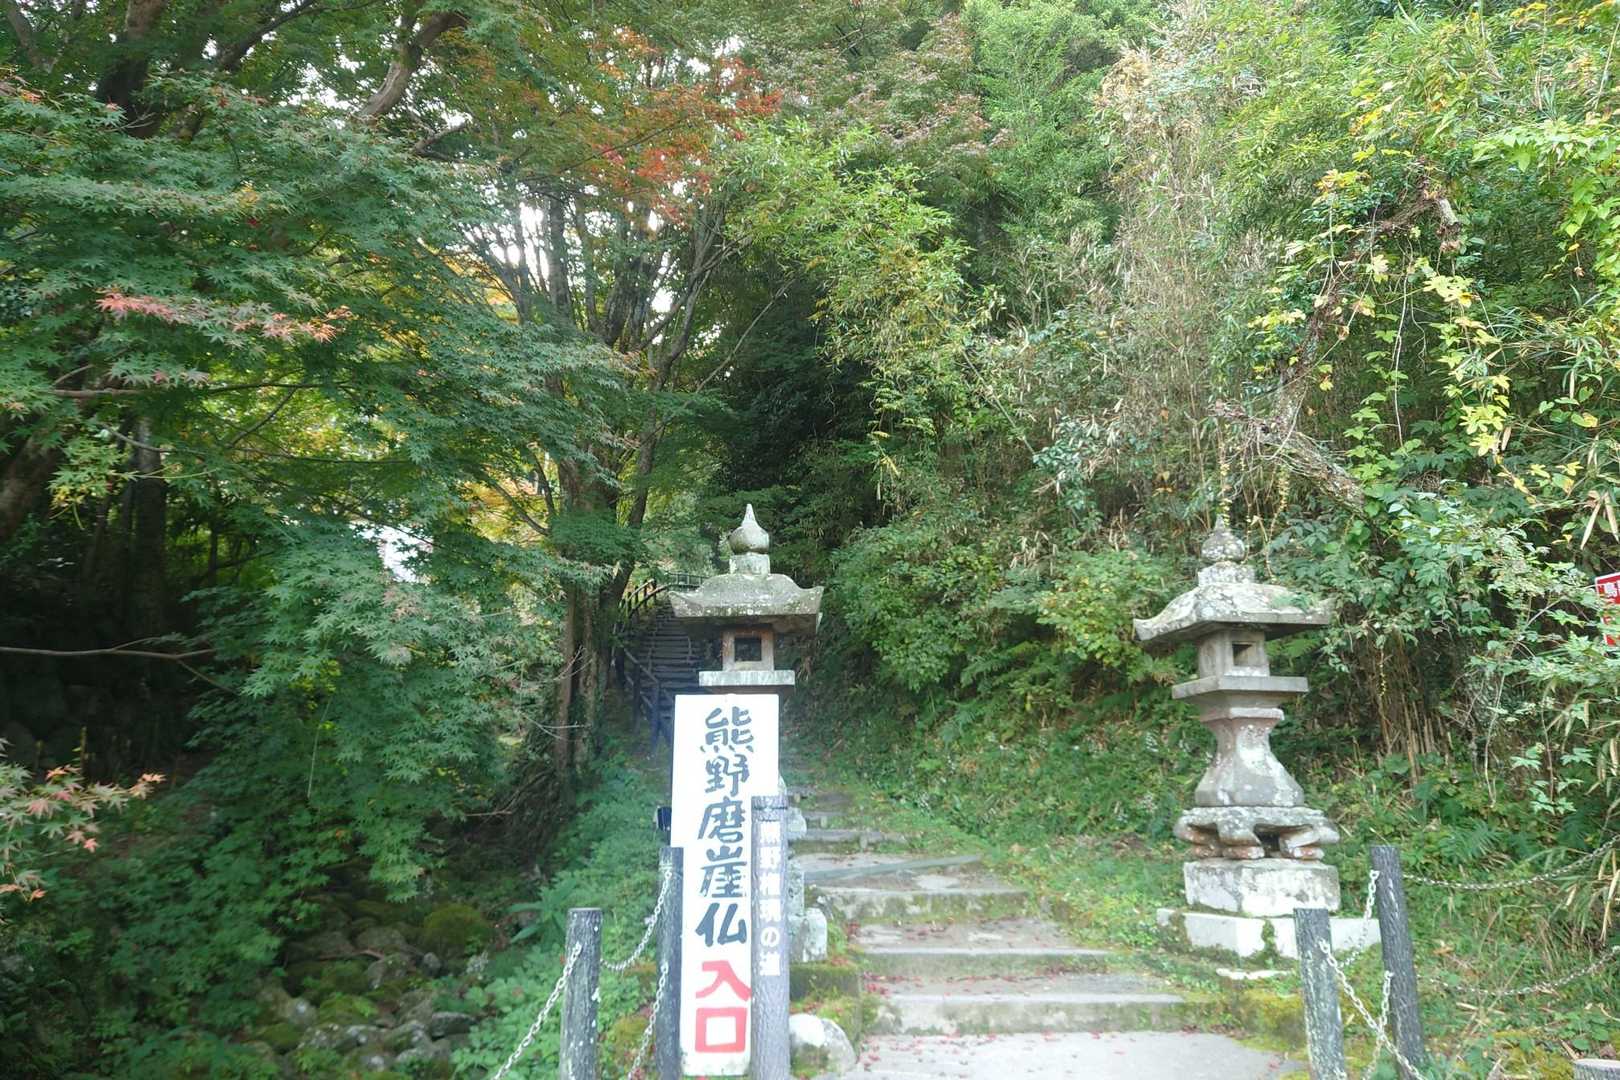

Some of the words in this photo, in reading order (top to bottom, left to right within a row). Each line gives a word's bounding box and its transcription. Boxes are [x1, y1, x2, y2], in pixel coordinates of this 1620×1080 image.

[695, 706, 754, 947] 熊野磨崖仏
[695, 960, 752, 1053] 入口
